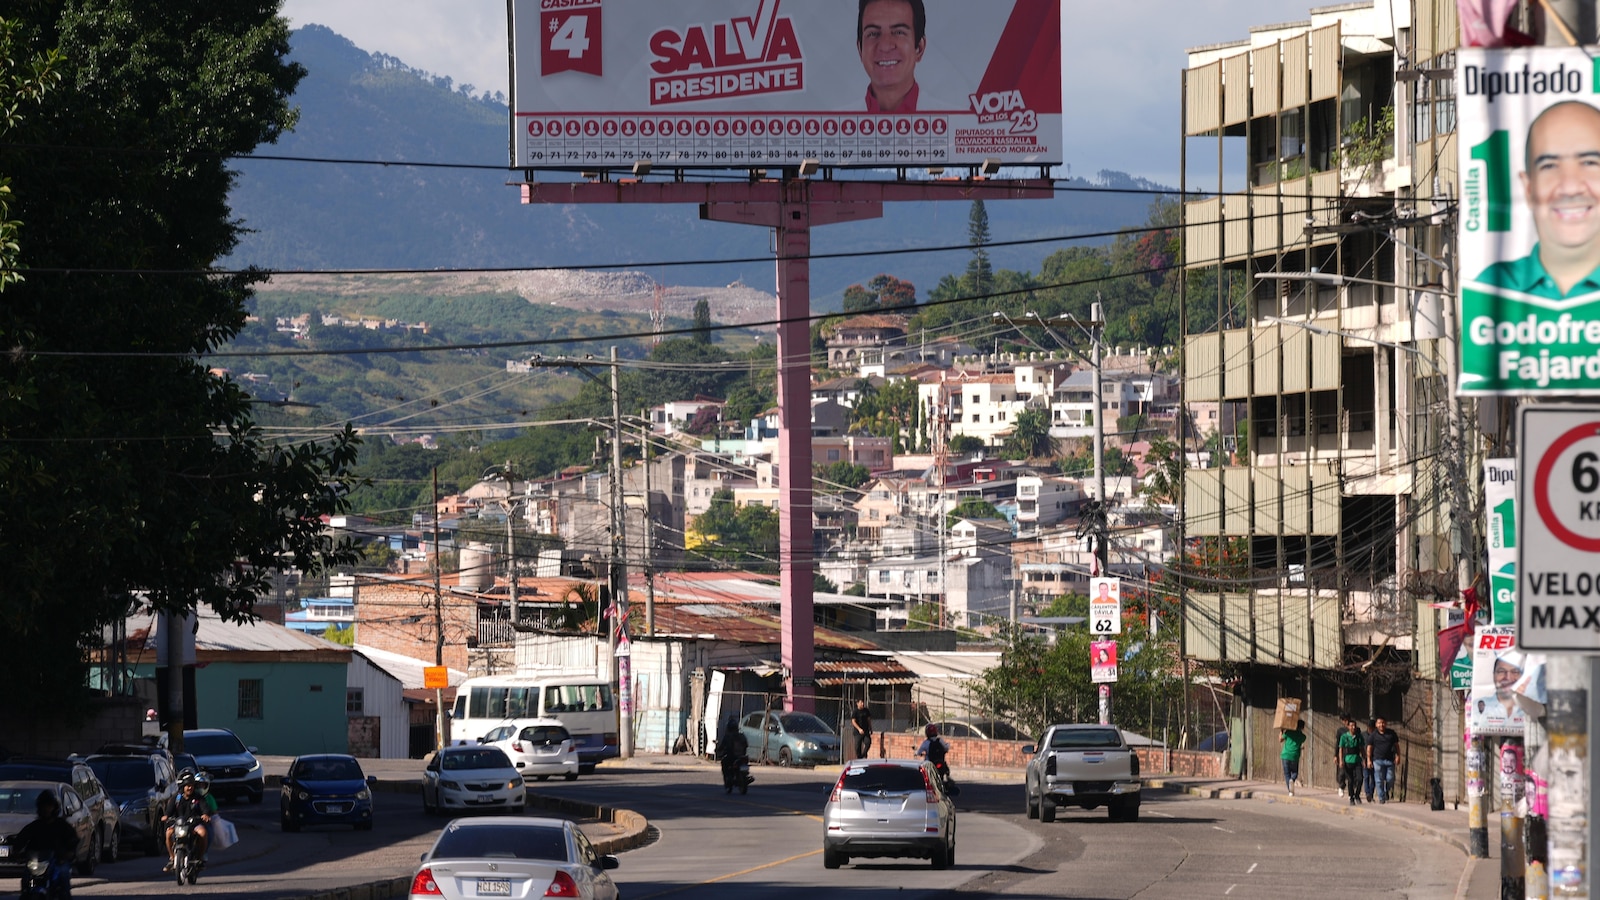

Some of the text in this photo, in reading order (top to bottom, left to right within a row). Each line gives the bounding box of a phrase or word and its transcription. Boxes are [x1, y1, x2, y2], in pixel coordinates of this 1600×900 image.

[650, 0, 802, 74] SALVA
[654, 67, 799, 100] PRESIDENTE
[1465, 62, 1582, 104] Diputado
[969, 89, 1026, 114] VOTA
[955, 128, 1006, 136] DIPUTADOS DE
[980, 110, 1037, 134] POR LOS 23
[955, 136, 1032, 145] SALVADOR NASRALLA
[955, 143, 1048, 154] EN FRANCISCO MORAZÁN
[530, 151, 543, 159] 70
[550, 151, 560, 159] 71
[567, 151, 578, 159] 72
[585, 151, 597, 159] 73
[604, 151, 615, 159] 74
[622, 151, 634, 159] 75
[659, 151, 670, 159] 77
[677, 151, 690, 159] 78
[696, 151, 708, 159] 79
[715, 151, 727, 159] 80
[733, 151, 744, 159] 81
[750, 151, 762, 159] 82
[768, 150, 780, 158] 83
[787, 150, 799, 158] 84
[805, 150, 817, 158] 85
[823, 150, 836, 158] 86
[842, 150, 854, 158] 87
[860, 150, 872, 158] 88
[879, 150, 891, 158] 89
[897, 150, 909, 158] 90
[916, 150, 926, 158] 91
[933, 150, 945, 158] 92
[1465, 166, 1480, 233] Casilla
[1095, 619, 1112, 632] 62
